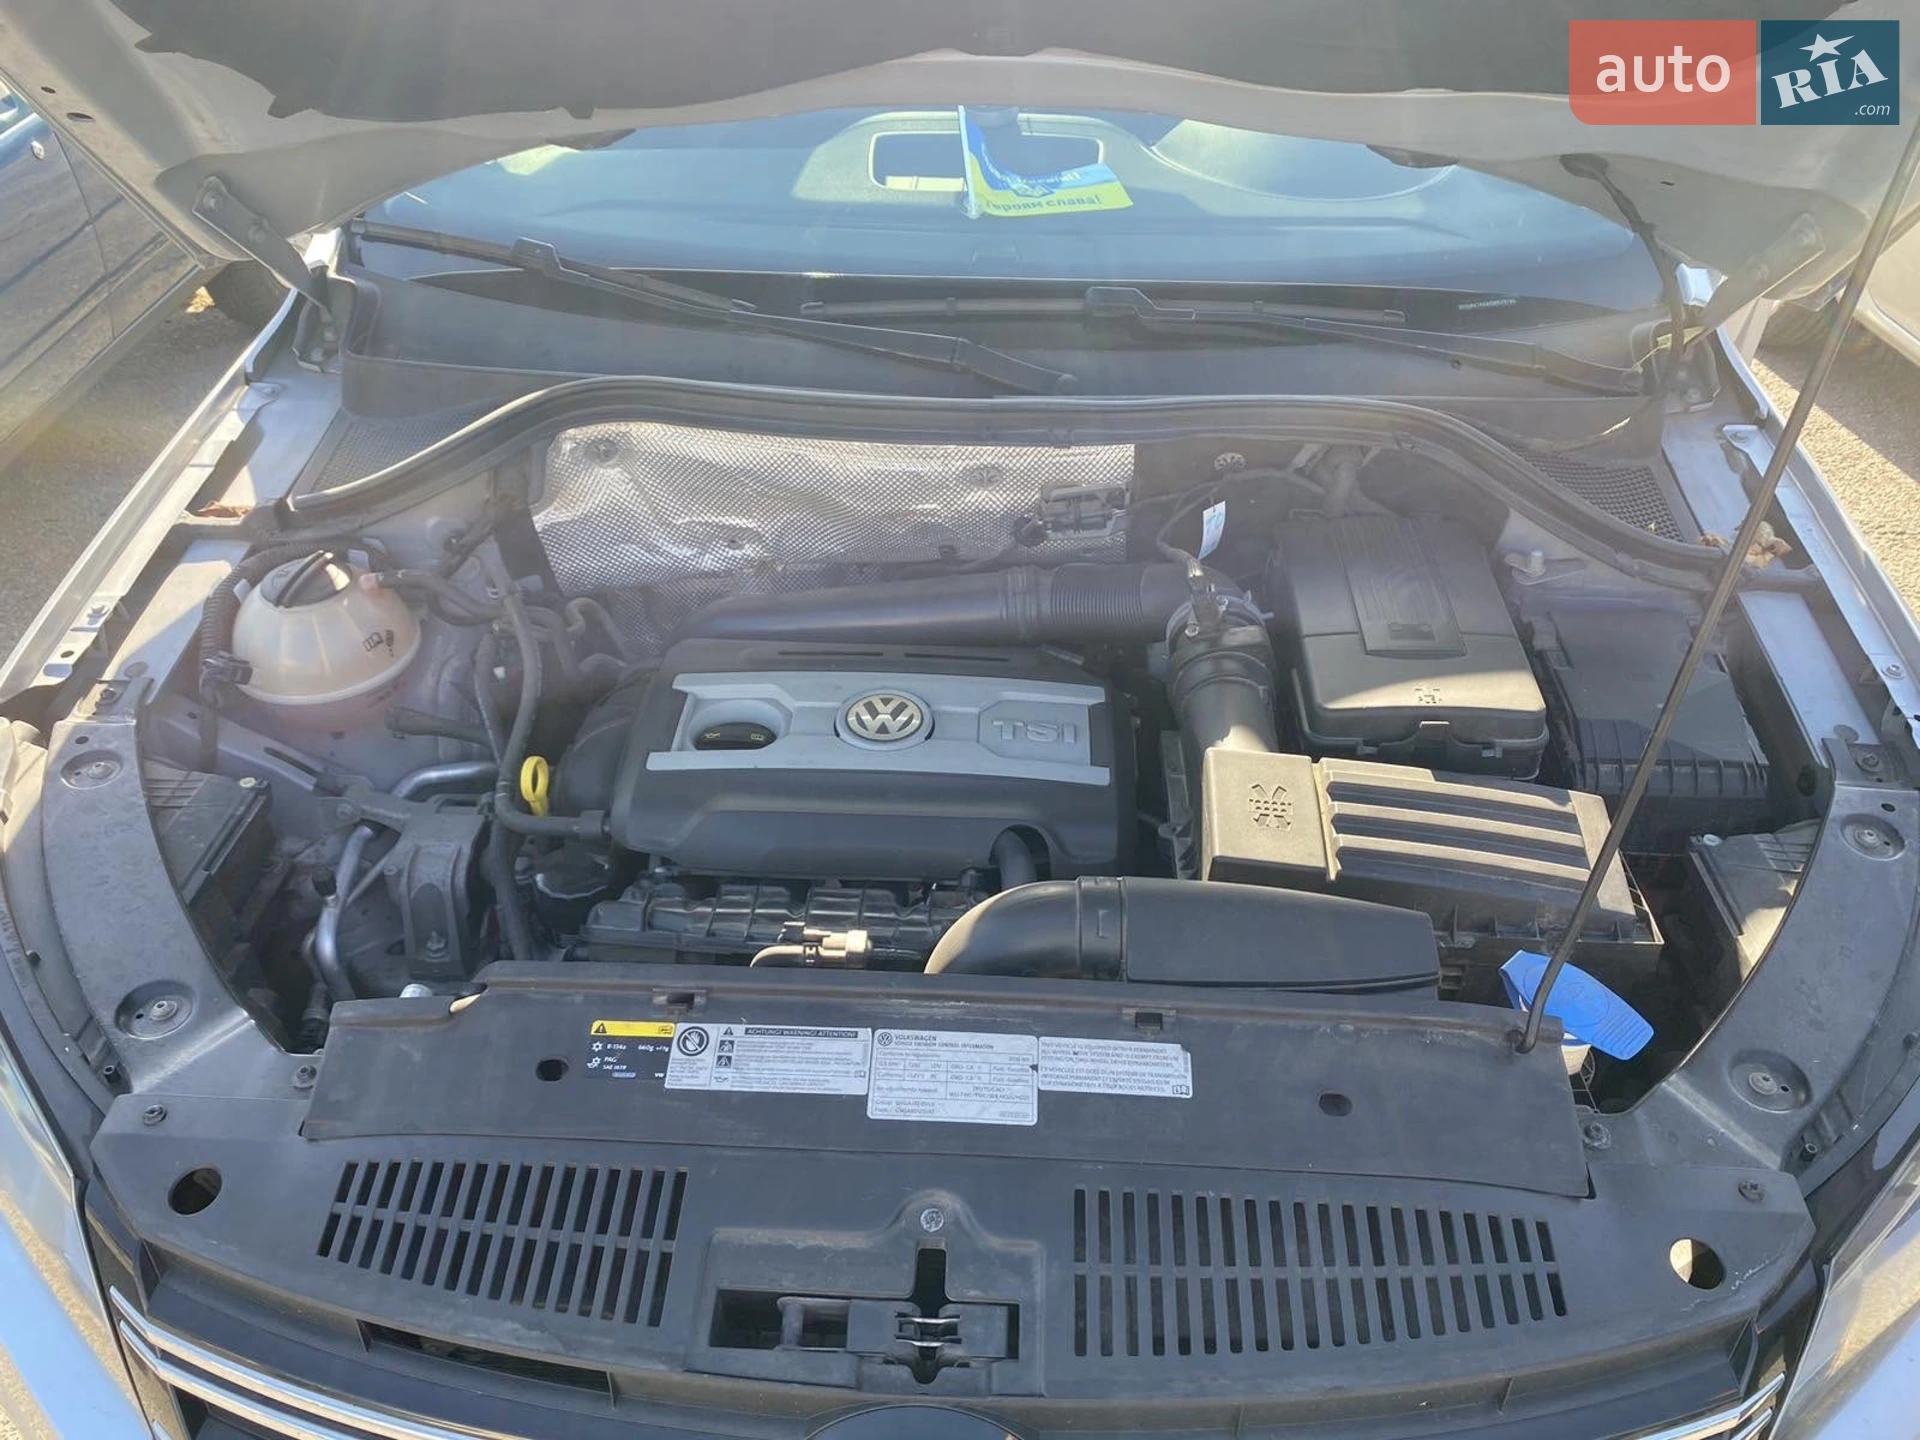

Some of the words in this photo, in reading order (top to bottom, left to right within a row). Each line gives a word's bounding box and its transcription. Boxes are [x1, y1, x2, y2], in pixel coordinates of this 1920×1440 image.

[1046, 193, 1102, 208] слава!
[991, 717, 1078, 745] TSI
[747, 1027, 782, 1036] ACHTUNG!
[783, 1028, 816, 1037] WARNING!
[818, 1030, 857, 1039] ATTENTION!
[894, 1034, 937, 1042] VOLKSWAGEN
